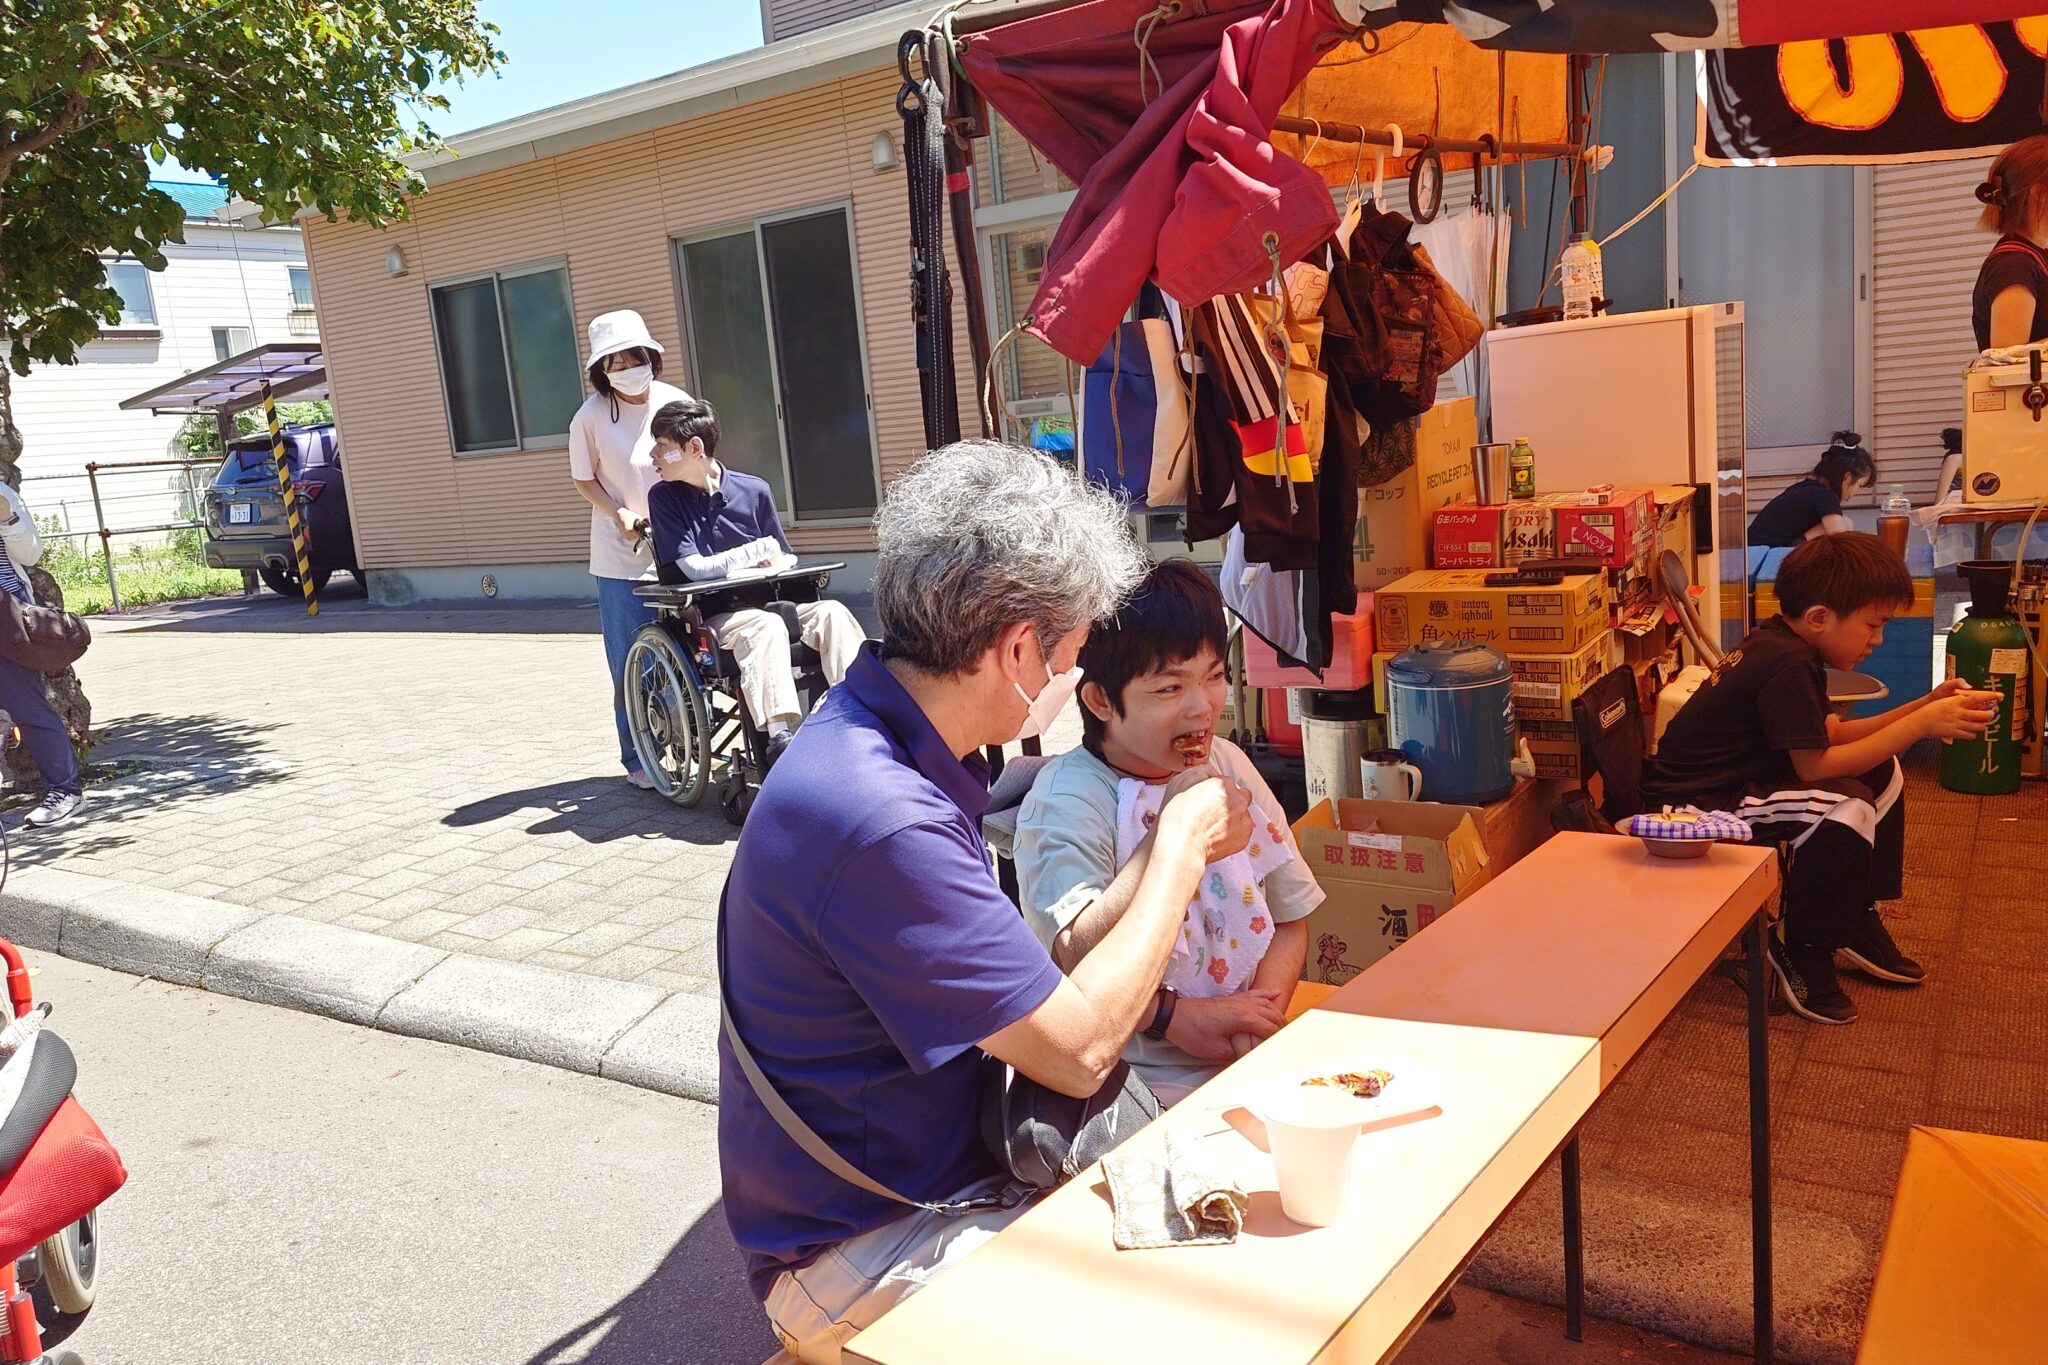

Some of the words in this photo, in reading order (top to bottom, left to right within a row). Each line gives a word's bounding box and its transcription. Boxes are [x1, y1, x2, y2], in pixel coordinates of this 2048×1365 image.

[1426, 467, 1452, 490] RECYCLE
[1504, 528, 1553, 549] Asahi
[1522, 549, 1536, 558] 生
[1439, 557, 1492, 566] スーパードライ
[1453, 600, 1489, 610] Suntory
[1453, 610, 1493, 623] Highball
[1419, 624, 1501, 642] 角ハイボール
[1324, 844, 1425, 873] 取扱注意
